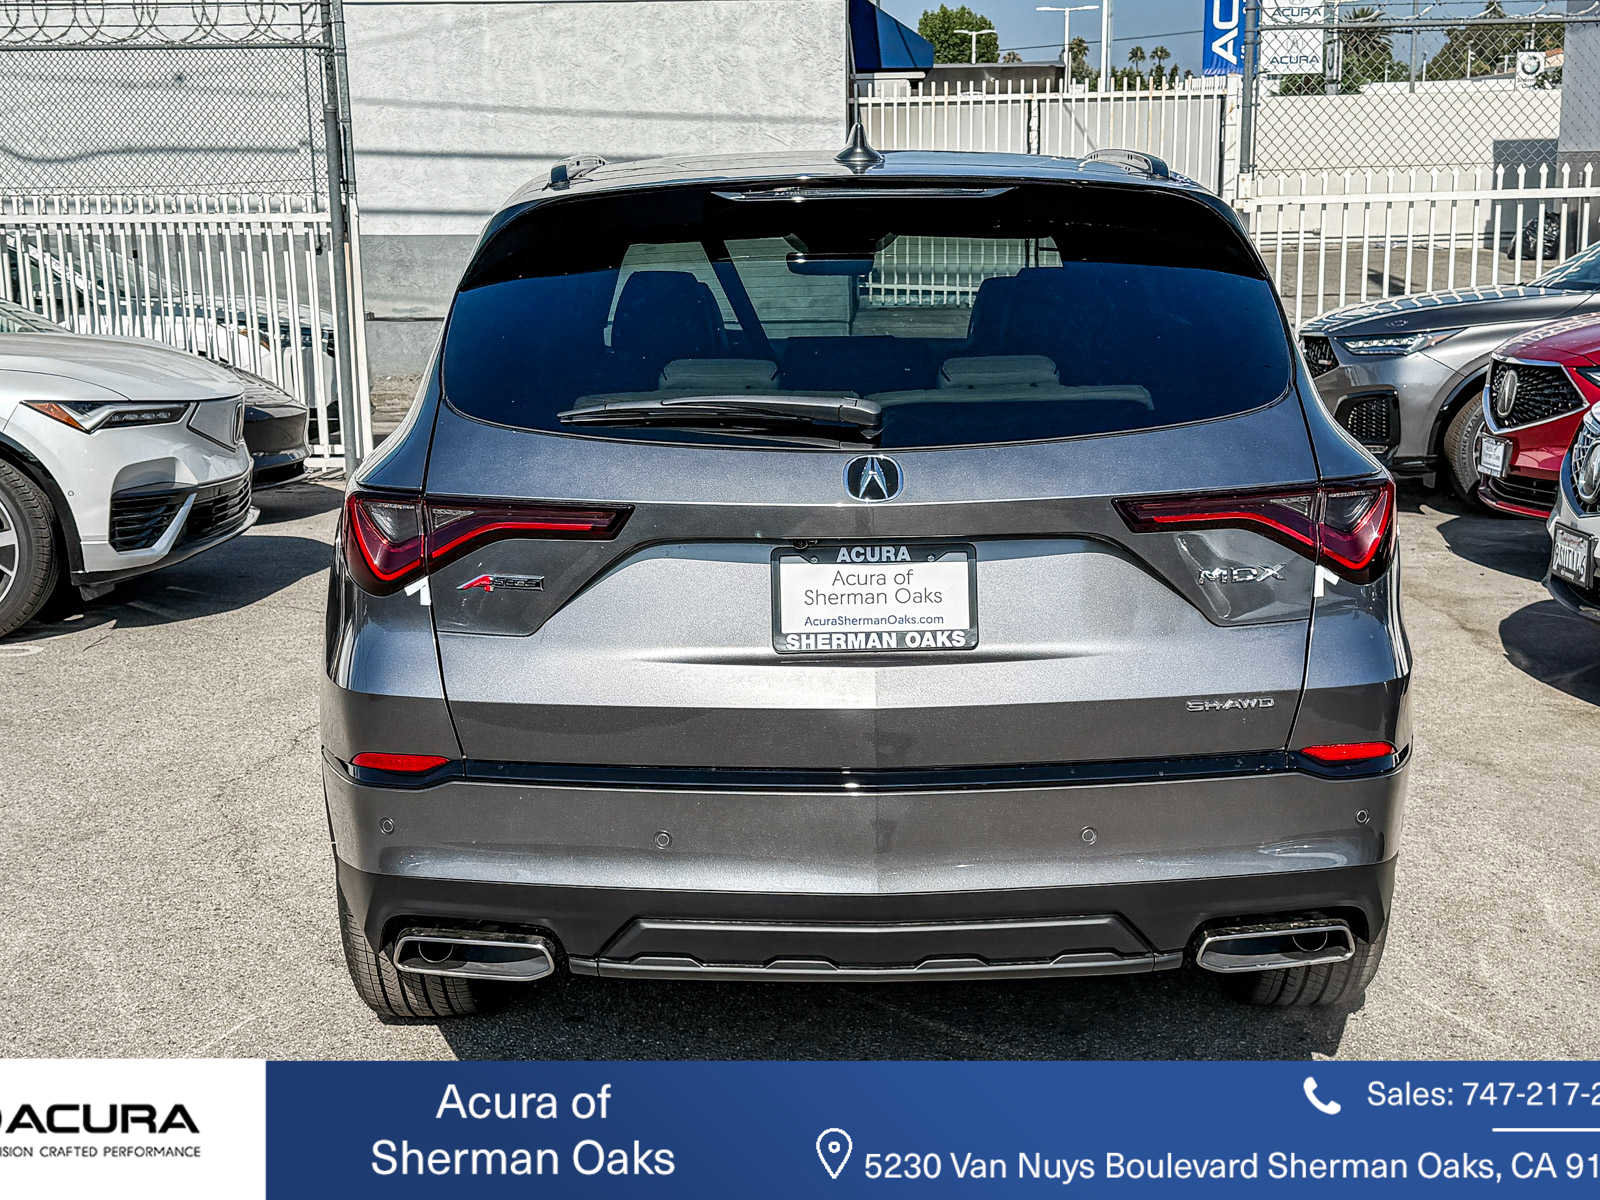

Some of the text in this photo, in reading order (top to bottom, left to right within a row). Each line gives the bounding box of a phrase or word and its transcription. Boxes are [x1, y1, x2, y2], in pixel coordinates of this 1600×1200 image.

[1271, 7, 1321, 17] ACURA
[1269, 55, 1320, 65] ACURA
[836, 546, 912, 563] ACURA
[831, 569, 914, 587] Acura of
[1199, 563, 1288, 585] MDX
[804, 587, 943, 606] Sherman Oaks
[804, 614, 945, 628] AcuraShermanOaks.com
[785, 631, 967, 651] SHERMAN OAKS
